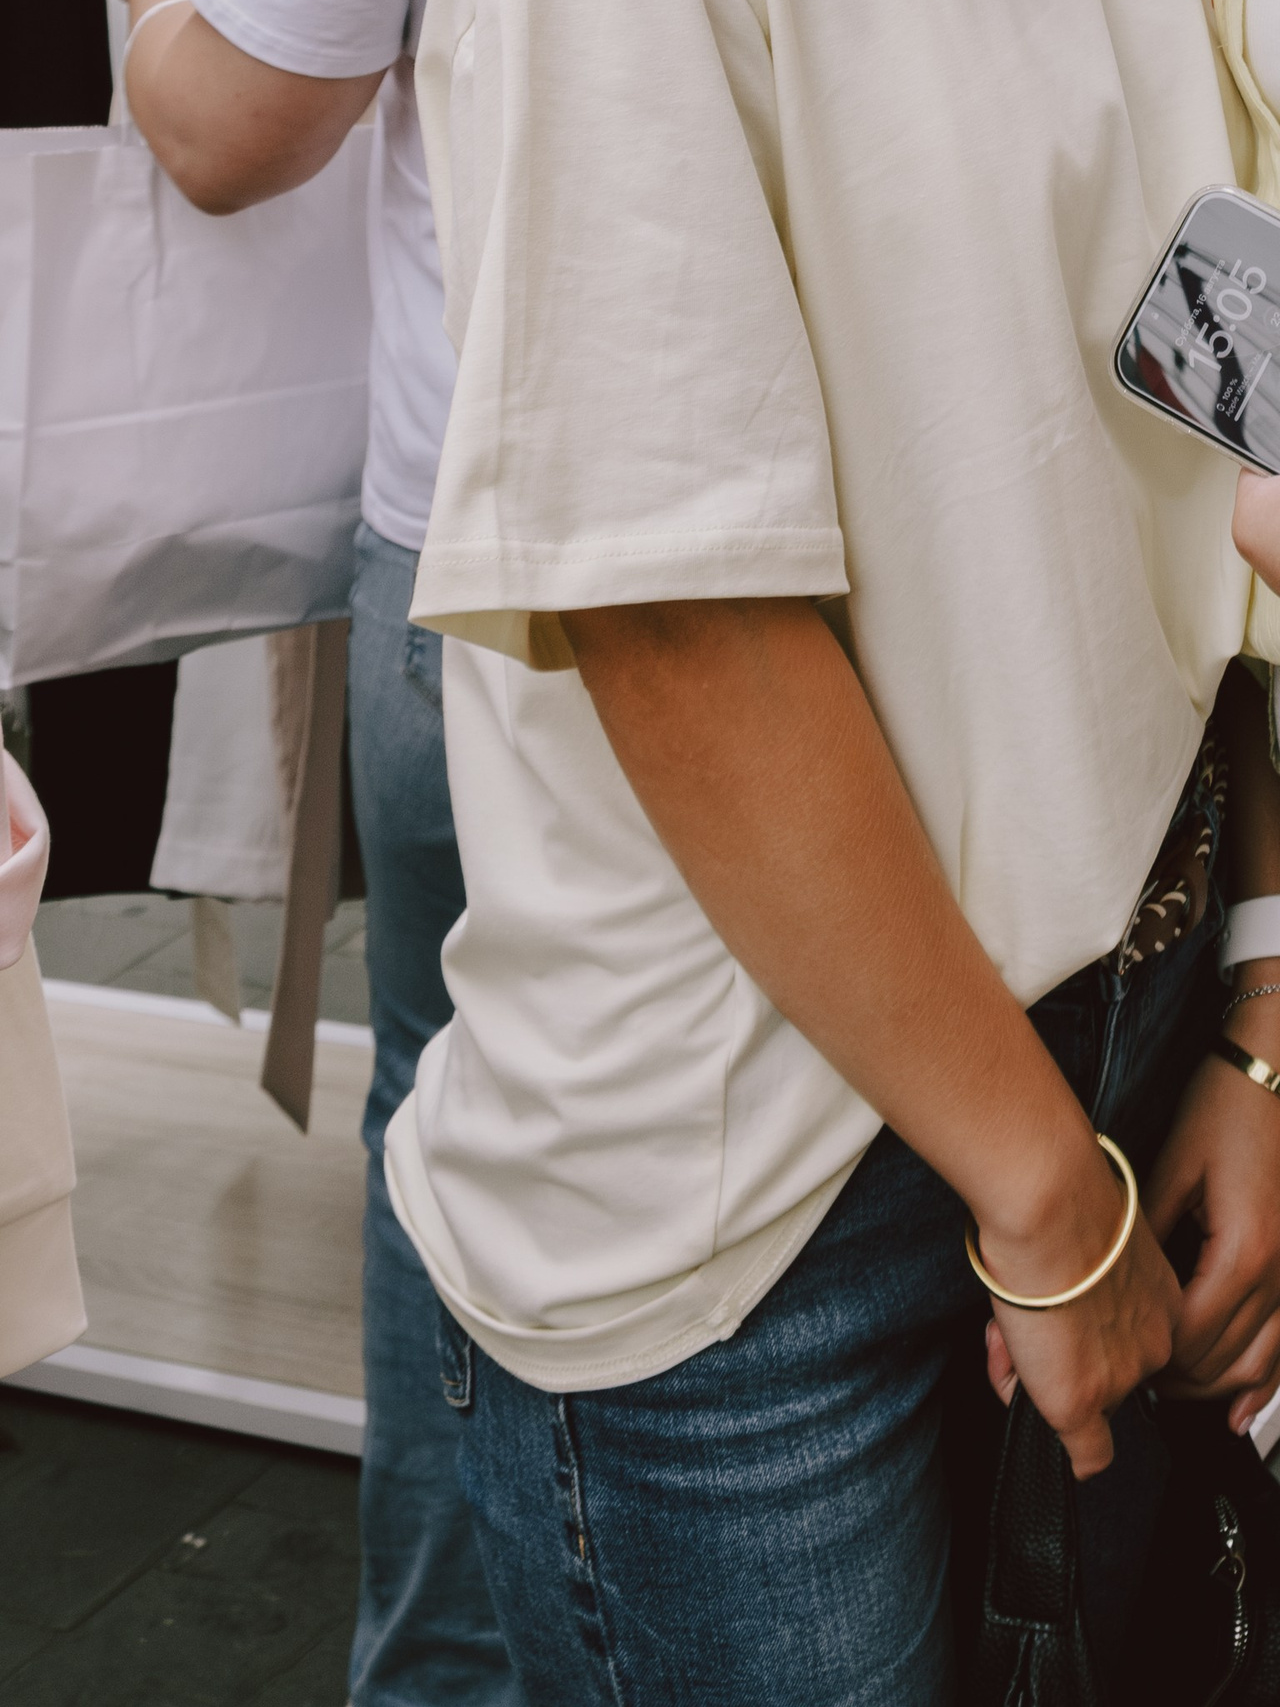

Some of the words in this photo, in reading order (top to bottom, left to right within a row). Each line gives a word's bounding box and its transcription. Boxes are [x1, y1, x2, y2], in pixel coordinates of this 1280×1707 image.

[1175, 307, 1204, 347] Суббота,
[1196, 293, 1208, 306] 16
[1204, 259, 1226, 295] августа
[1188, 259, 1267, 372] 15:05
[1225, 395, 1240, 418] Apple
